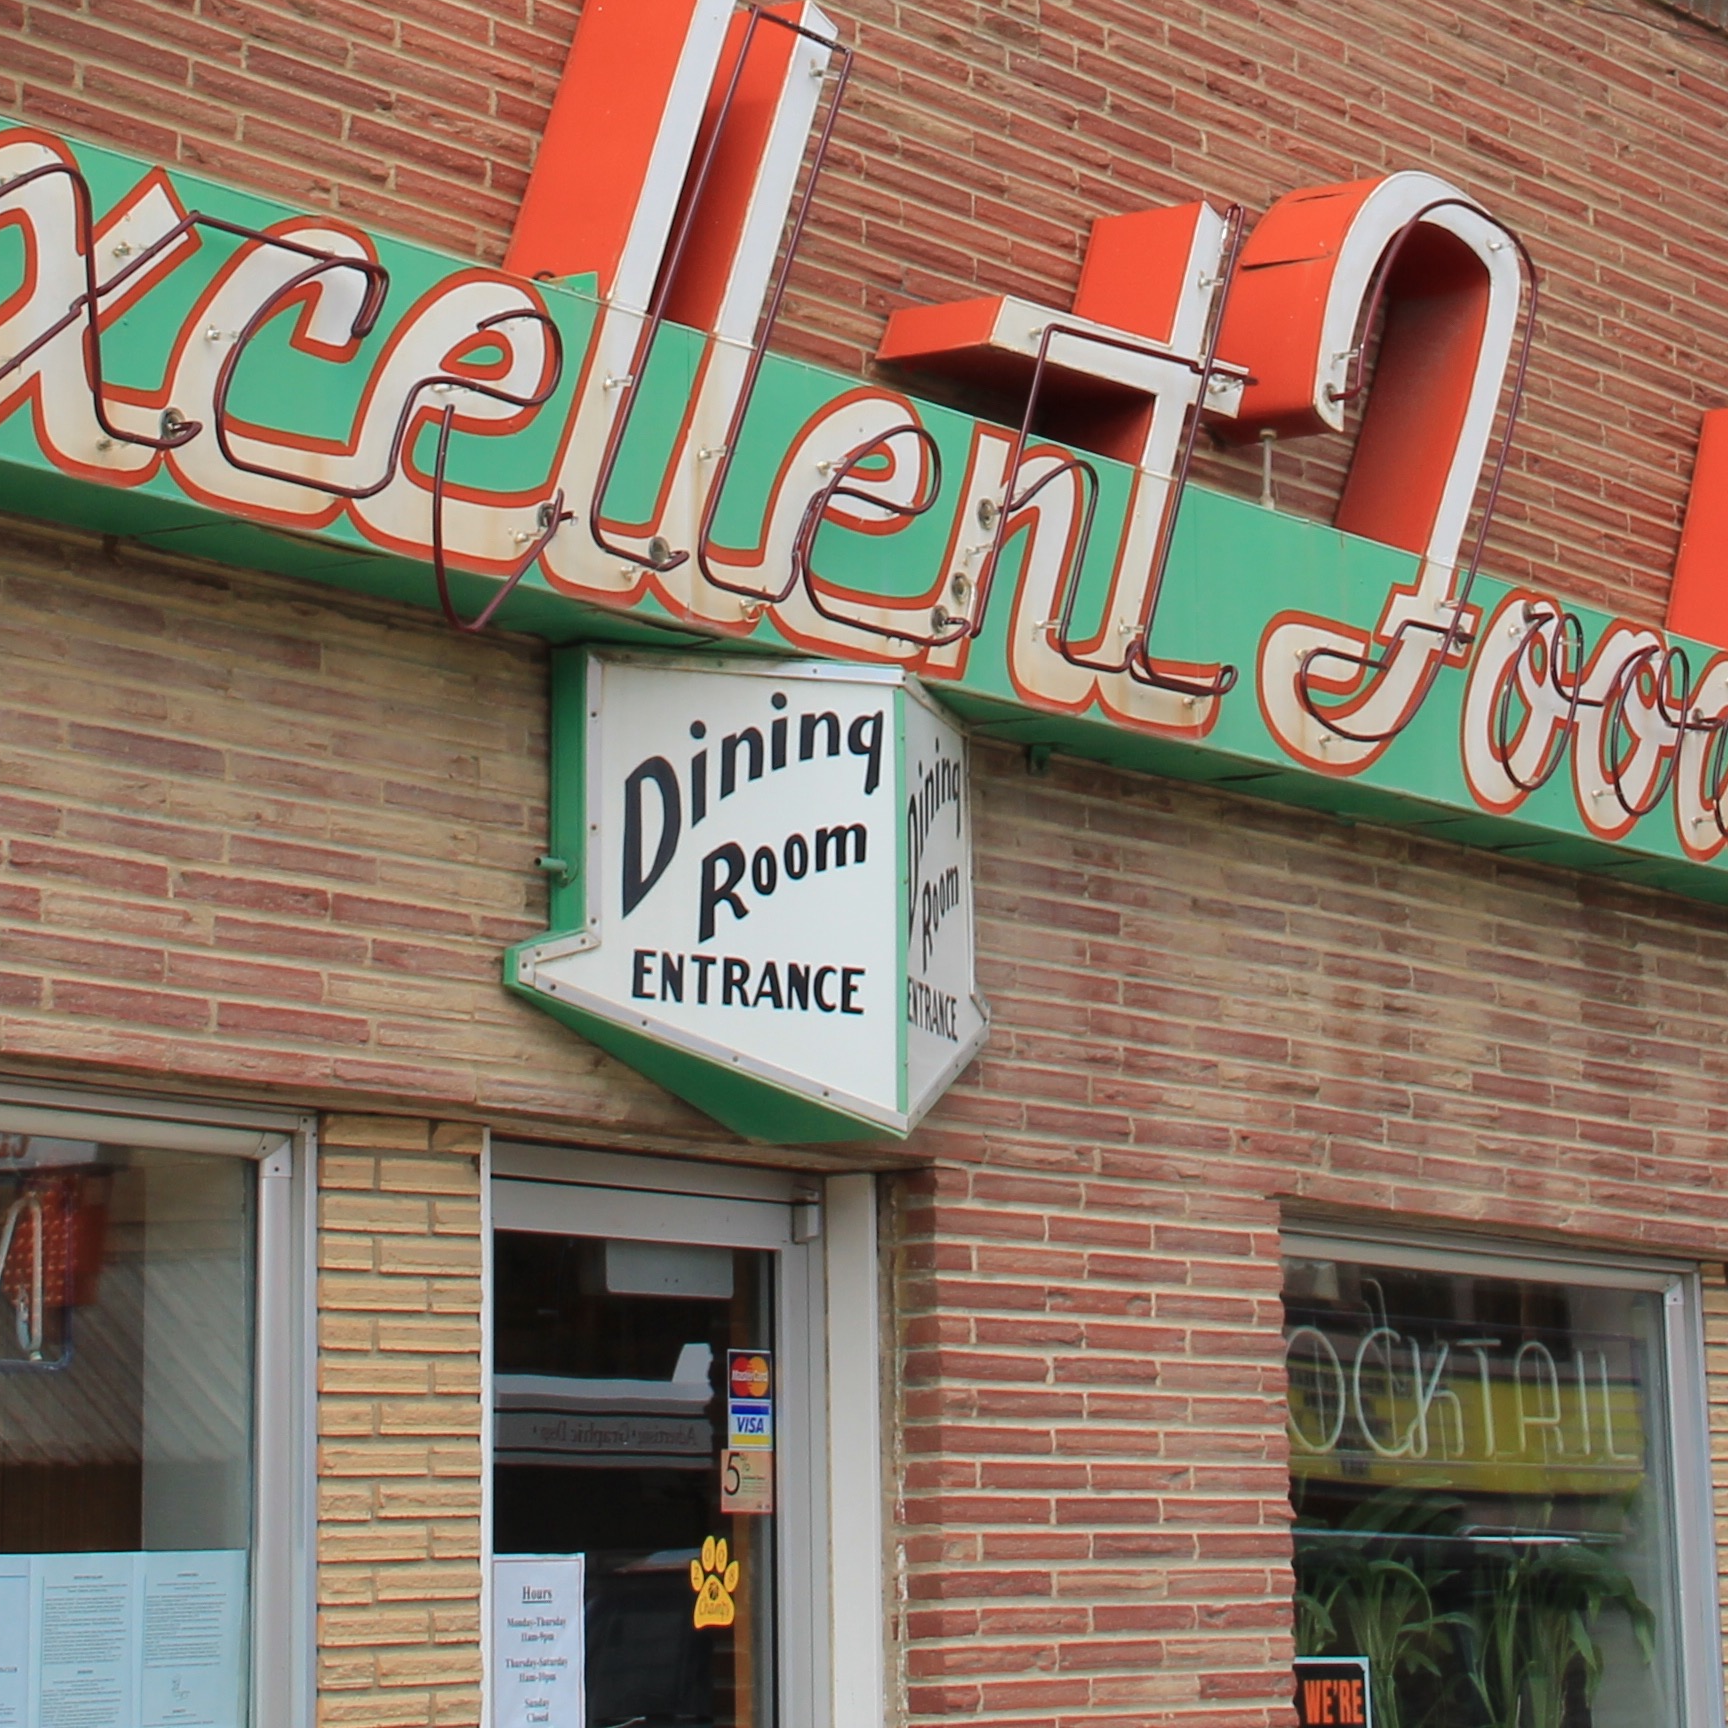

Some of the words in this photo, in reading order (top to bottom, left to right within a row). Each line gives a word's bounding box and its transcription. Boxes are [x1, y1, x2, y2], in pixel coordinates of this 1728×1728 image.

[622, 691, 884, 920] Dining
[907, 737, 961, 953] Dining
[698, 821, 868, 944] Room
[922, 865, 960, 976] Room
[632, 949, 866, 1015] ENTRANCE
[907, 976, 959, 1043] ENTRANCE
[736, 1416, 765, 1434] VISA
[507, 1617, 567, 1630] Monday-Thursday
[522, 1585, 553, 1601] Hours
[525, 1698, 550, 1710] Sunday
[1303, 1679, 1365, 1724] WE'RE
